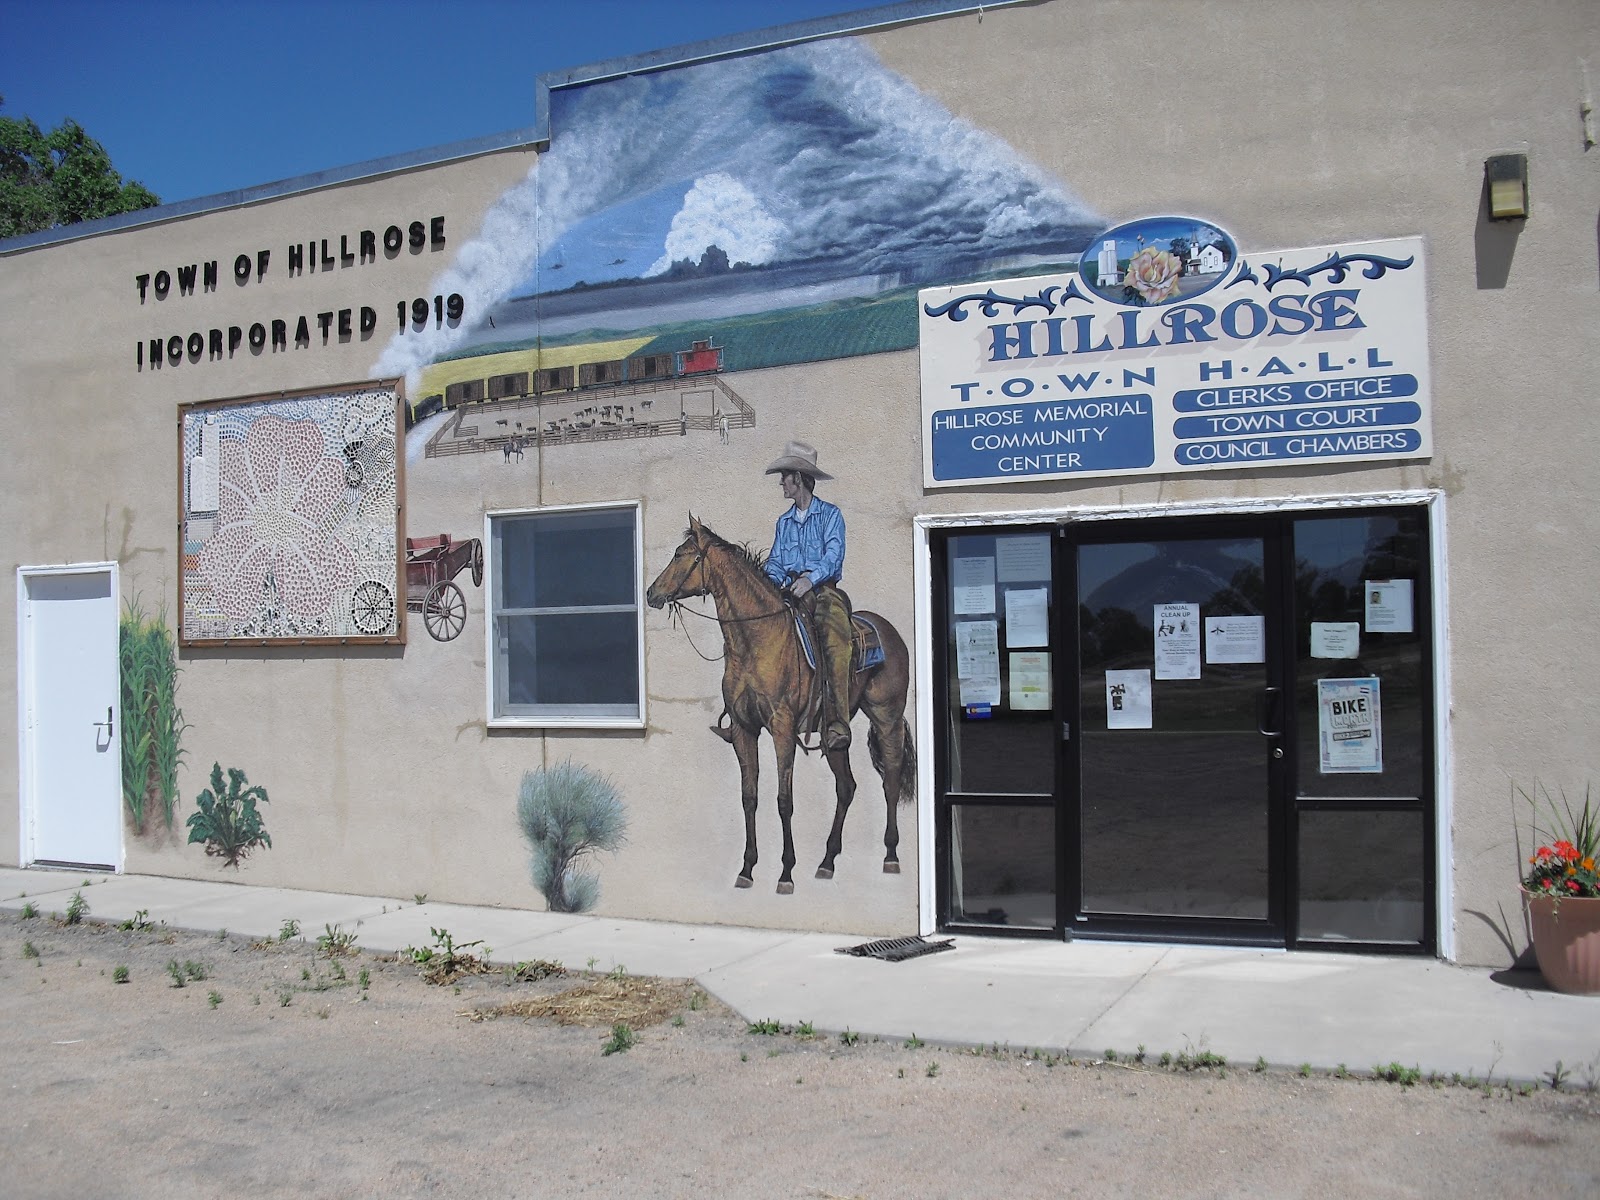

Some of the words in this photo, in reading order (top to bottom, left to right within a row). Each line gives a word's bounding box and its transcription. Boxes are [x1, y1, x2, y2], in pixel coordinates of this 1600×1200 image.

[136, 260, 218, 301] TOWN
[234, 250, 271, 281] OF
[288, 216, 446, 271] HILLROSE
[136, 306, 377, 366] INCORPORATED
[397, 293, 465, 328] 1919
[988, 289, 1367, 362] HILLROSE
[1196, 385, 1293, 408] CLERKS
[1304, 377, 1392, 400] OFFICE
[935, 409, 1024, 430] HILLROSE
[1033, 400, 1148, 423] MEMORIAL
[1207, 413, 1285, 433] TOWN
[1295, 407, 1384, 427] COURT
[971, 426, 1109, 451] COMMUNITY
[1185, 440, 1276, 461] COUNCIL
[1286, 432, 1408, 455] CHAMBERS
[998, 453, 1083, 472] CENTER
[1332, 698, 1367, 715] BIKE
